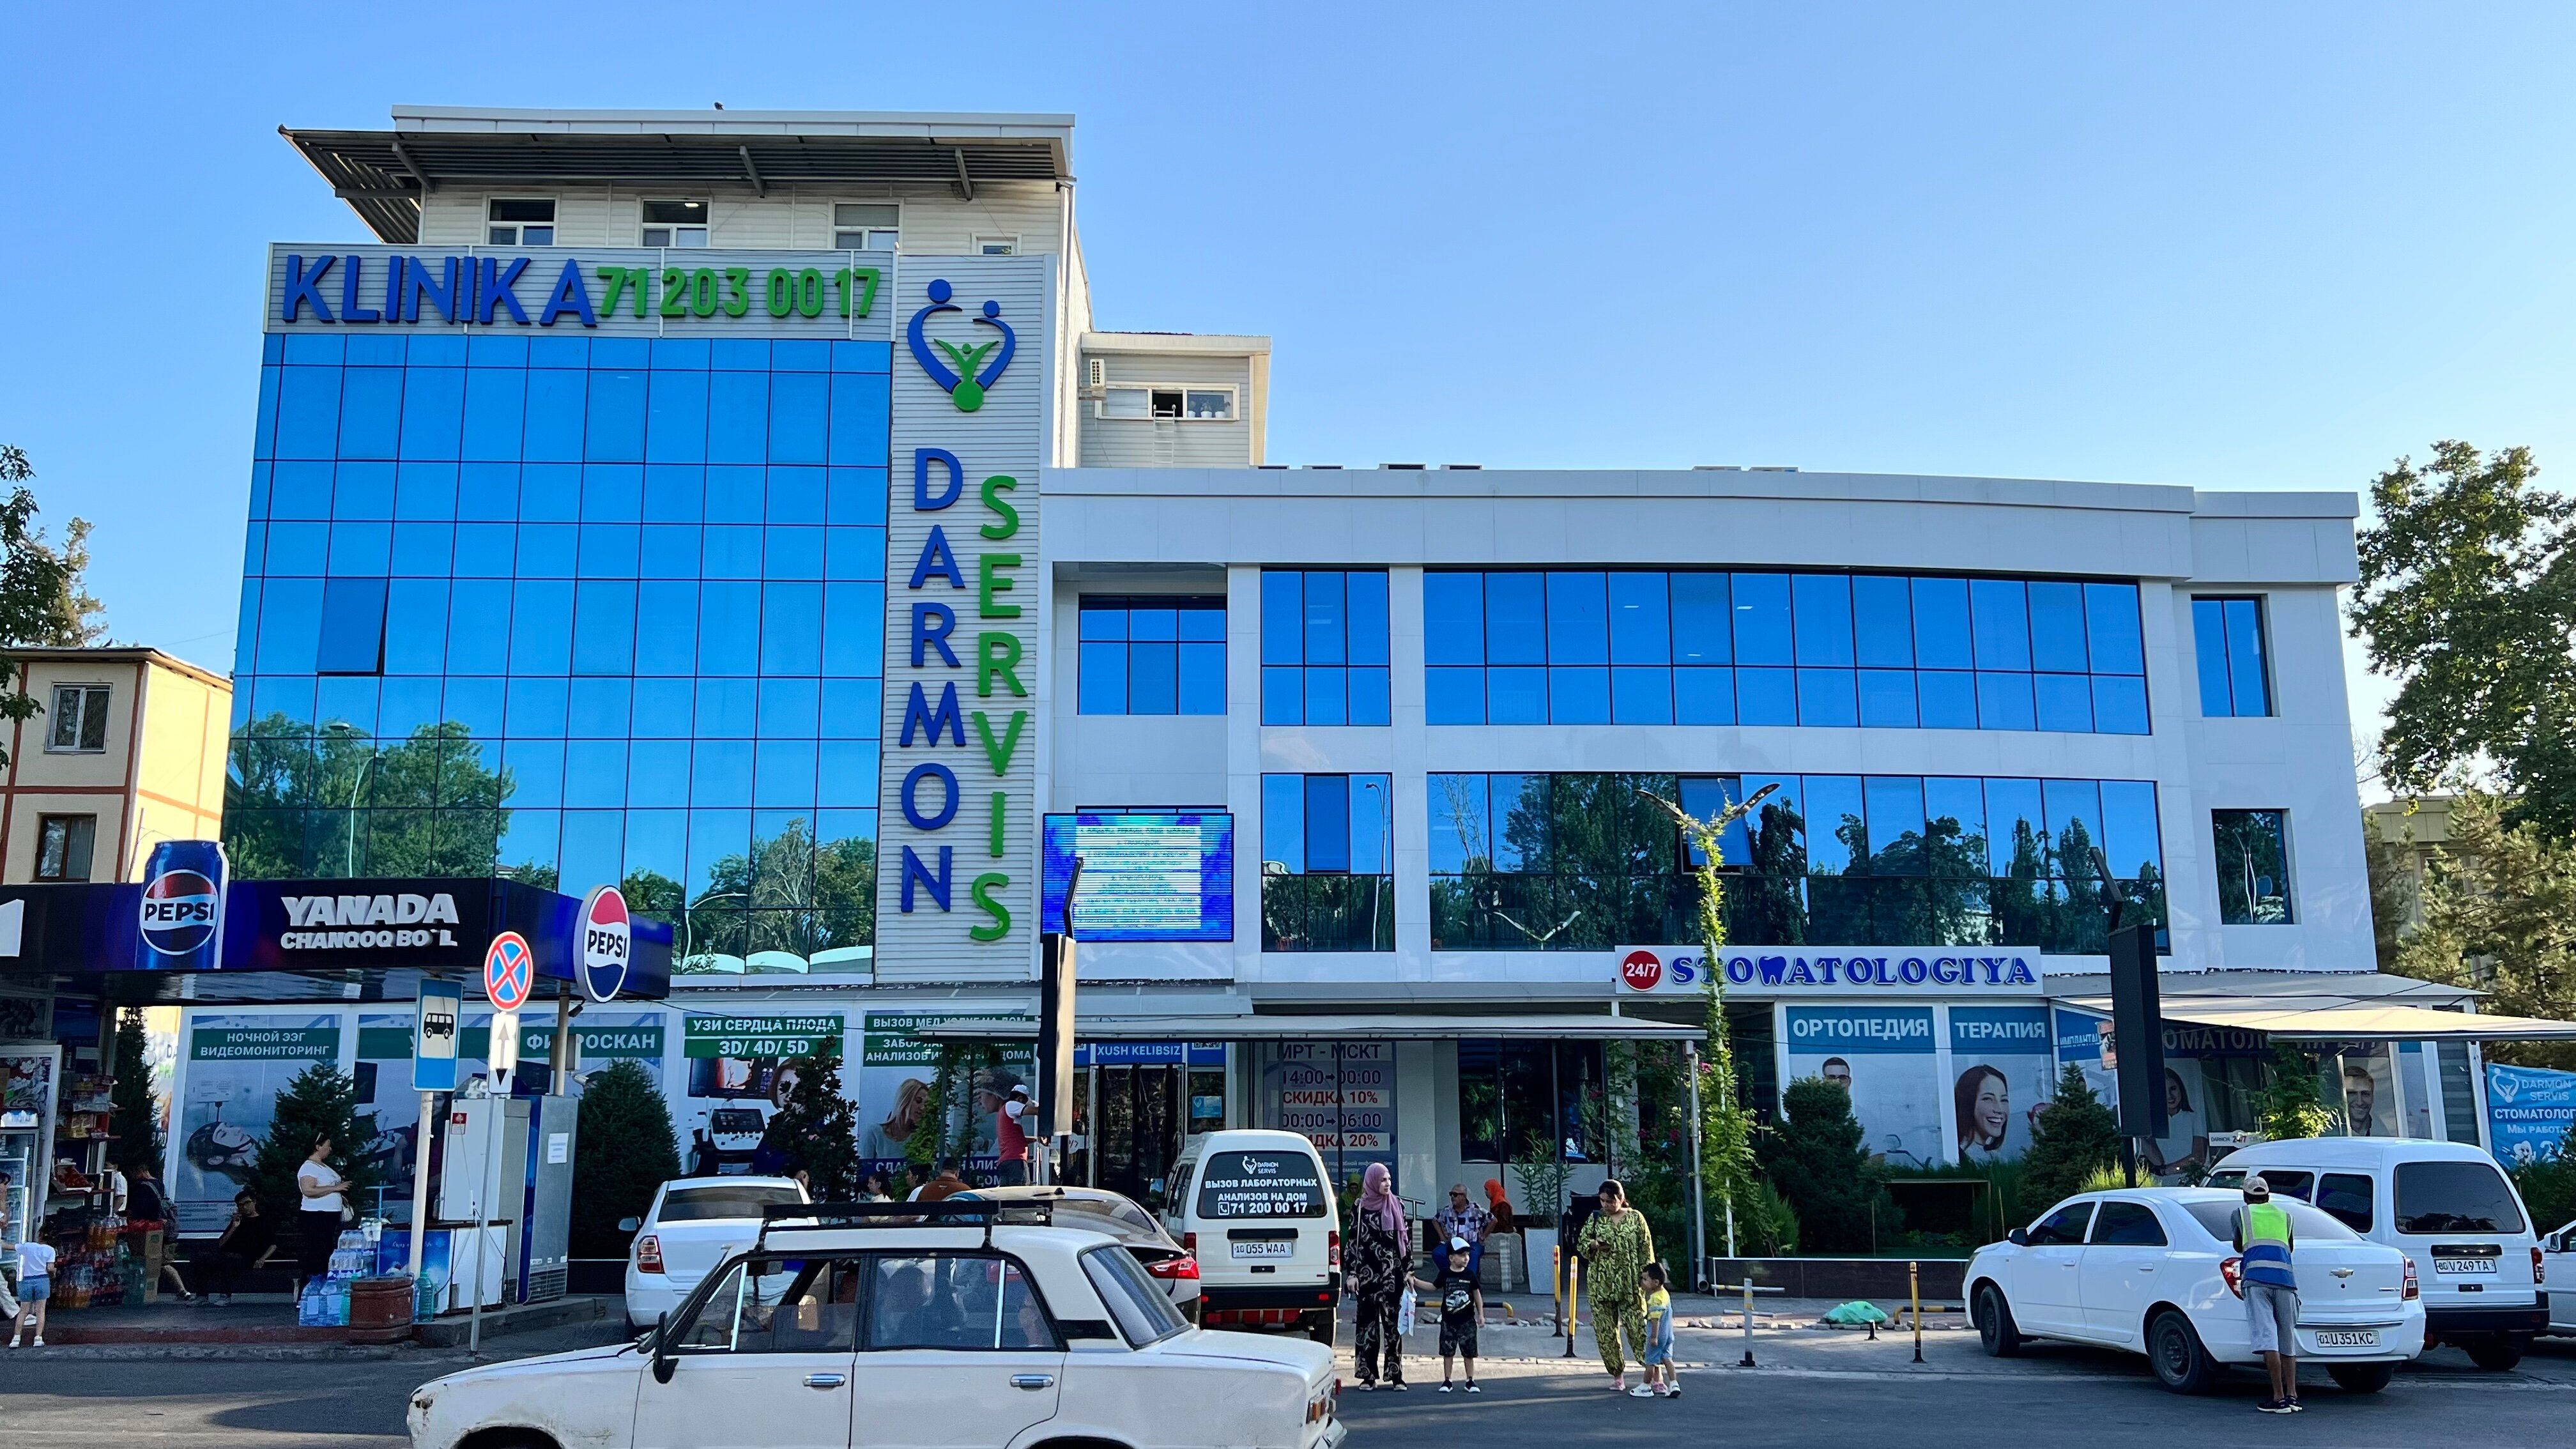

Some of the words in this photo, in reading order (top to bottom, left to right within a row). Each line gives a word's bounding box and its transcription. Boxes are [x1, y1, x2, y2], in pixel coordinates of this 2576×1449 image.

[282, 254, 597, 328] KLINIKA
[596, 266, 648, 317] 71
[660, 266, 748, 318] 203
[899, 448, 966, 912] DARMON
[969, 475, 1028, 941] SERVIS
[144, 901, 215, 922] PEPSI
[281, 894, 459, 927] YANADA
[280, 931, 395, 950] CHANQOQ
[587, 930, 628, 958] PEPSI
[1626, 963, 1658, 978] 24/7
[693, 1020, 721, 1032] УЗИ
[725, 1019, 783, 1034] СЕРДЦА
[786, 1018, 837, 1032] ПЛОДА
[873, 1018, 913, 1027] ВЫЗОВ
[1793, 1018, 1929, 1041] ОРТОПЕДИЯ
[1956, 1022, 2046, 1038] ТЕРАПИЯ
[227, 1031, 279, 1043] НОЧНОЙ
[200, 1045, 330, 1058] ВИДЕОМОНИТОРИНГ
[719, 1041, 749, 1055] 3D/
[753, 1041, 783, 1055] 4D/
[787, 1041, 809, 1055] 5D
[1097, 1046, 1128, 1056] XUSH
[1131, 1045, 1181, 1055] KELIBSIZ
[866, 1051, 928, 1061] АНАЛИЗОВ
[2522, 1080, 2572, 1089] DARMON
[1349, 1091, 1378, 1104] 10%
[2530, 1091, 2570, 1101] SERVIS
[2507, 1124, 2526, 1133] Мы
[1349, 1134, 1379, 1147] 20%
[1205, 1179, 1238, 1188] ВЫЗОВ
[1241, 1178, 1317, 1188] ЛАБОРАТОРНЫХ
[1218, 1193, 1268, 1201] АНАЛИЗОВ
[1286, 1192, 1307, 1202] ДОМ
[1230, 1203, 1245, 1214] 71
[1249, 1202, 1271, 1213] 200
[1275, 1202, 1290, 1213] 00
[1293, 1202, 1308, 1213] 17
[1246, 1243, 1263, 1254] 055
[1266, 1243, 1285, 1254] WAA
[2319, 1335, 2329, 1344] 01
